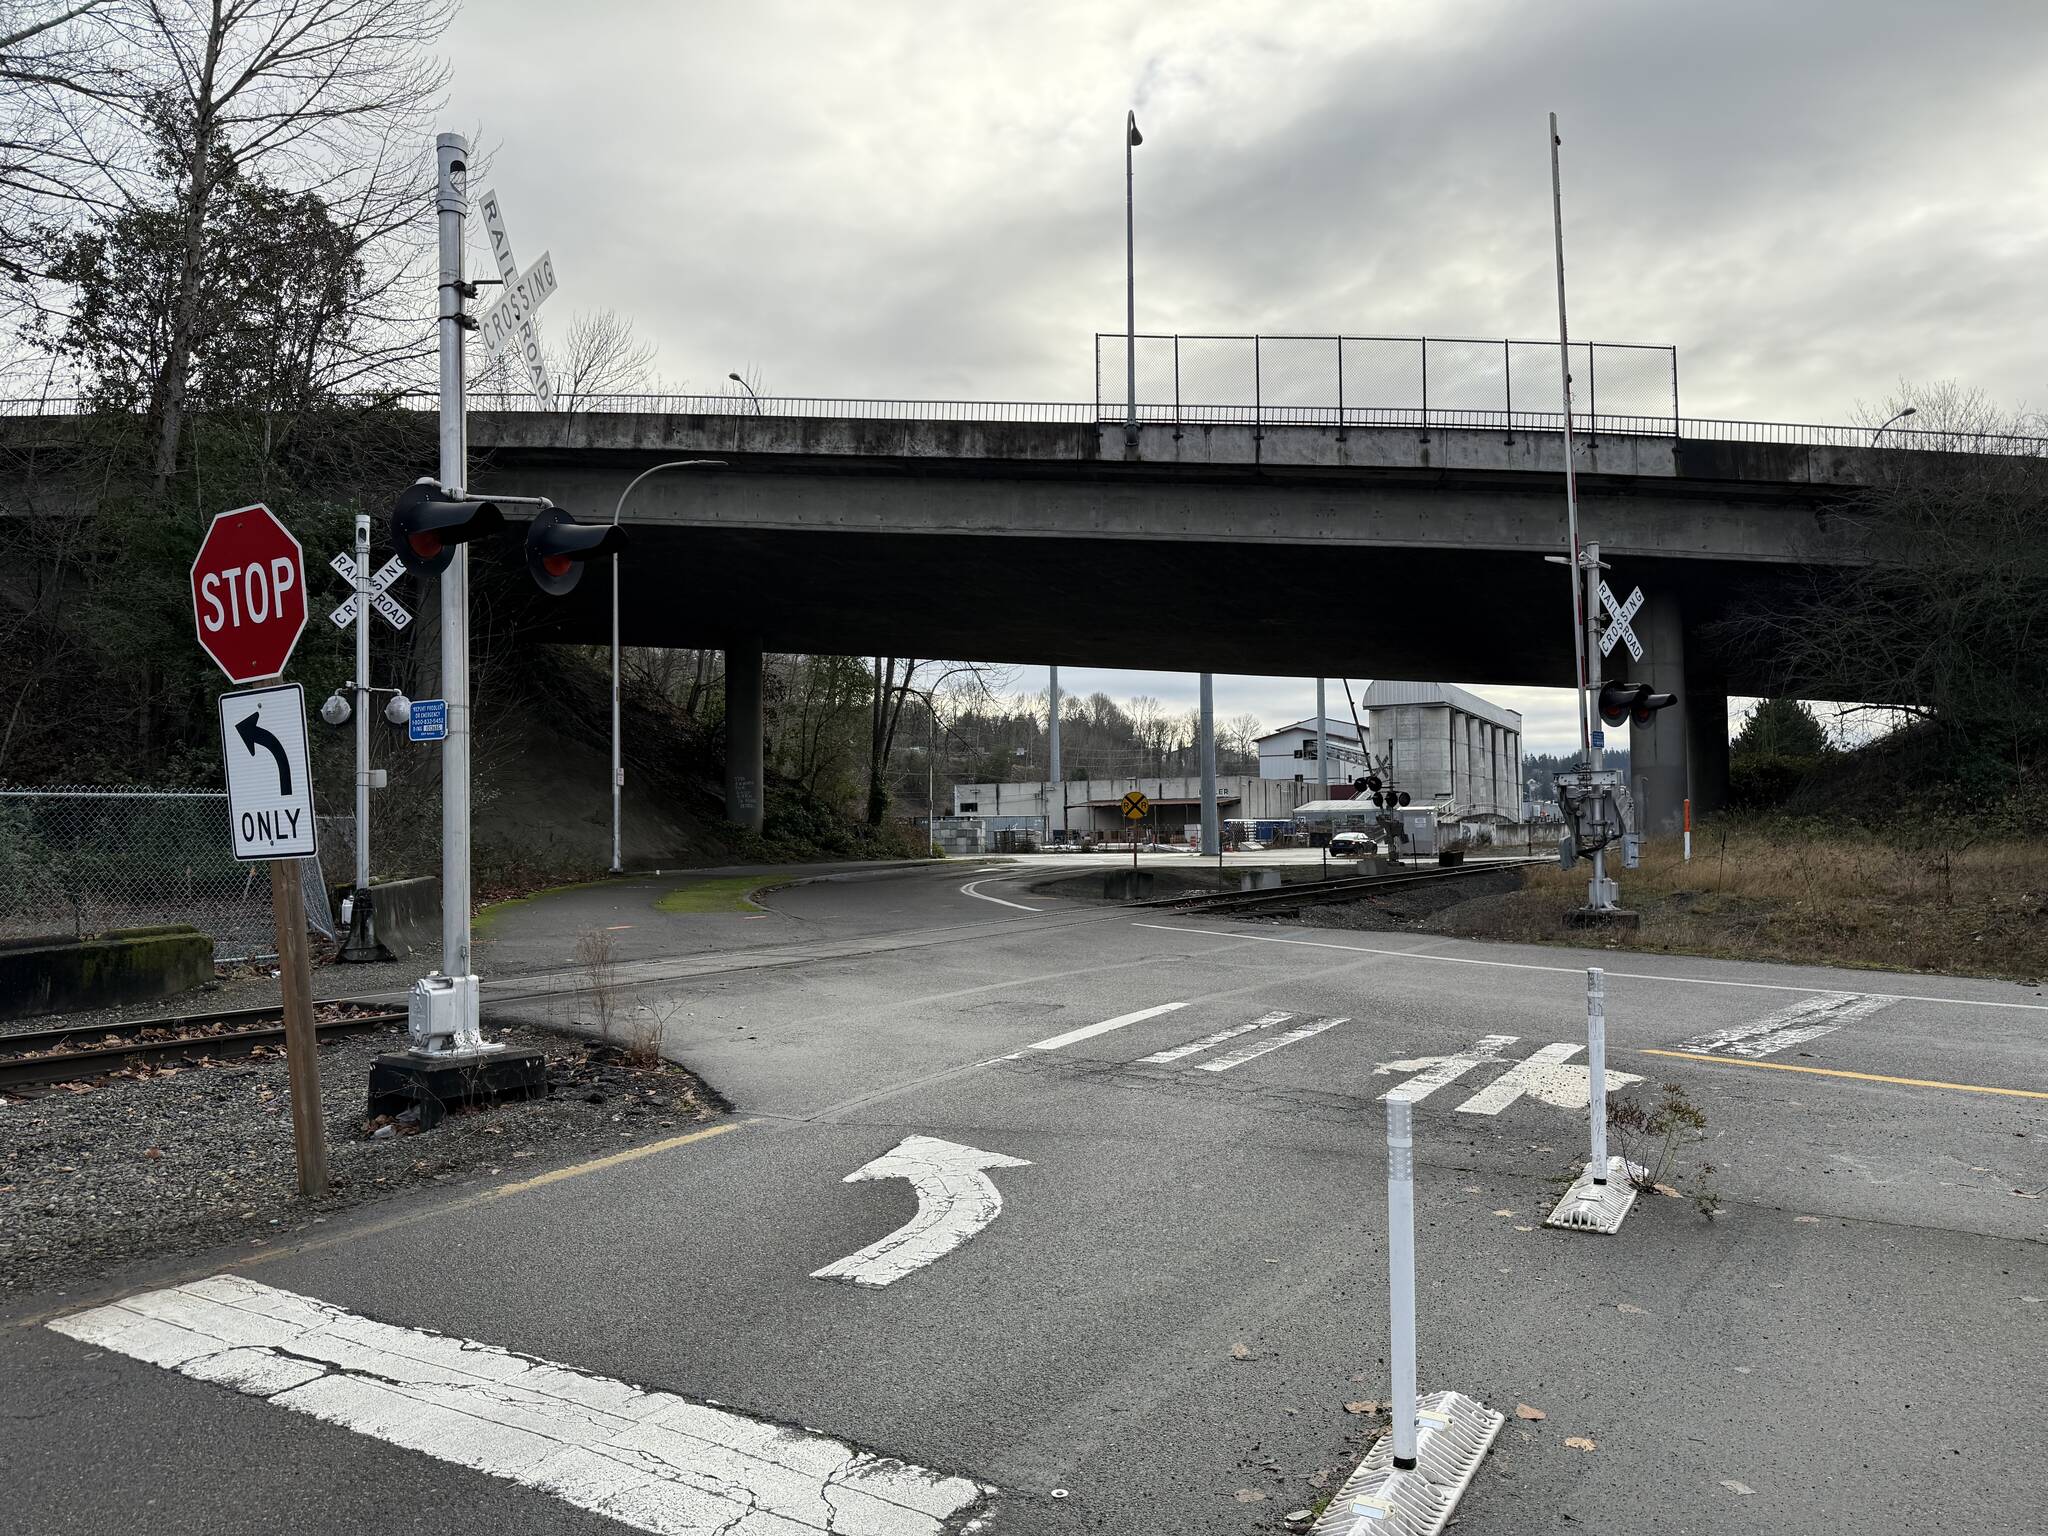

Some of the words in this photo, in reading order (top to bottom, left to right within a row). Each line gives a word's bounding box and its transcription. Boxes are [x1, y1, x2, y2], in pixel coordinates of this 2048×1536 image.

[483, 199, 516, 287] RAIL
[483, 260, 554, 350] CROSSING
[520, 320, 549, 403] ROAD
[201, 556, 295, 632] STOP
[334, 556, 357, 581] RAI
[335, 557, 405, 624] CRSING
[373, 594, 407, 625] ROAD
[1599, 584, 1618, 618] RAIL
[1602, 591, 1642, 653] CROSSING
[1622, 626, 1641, 657] ROAD
[241, 808, 301, 842] ONLY
